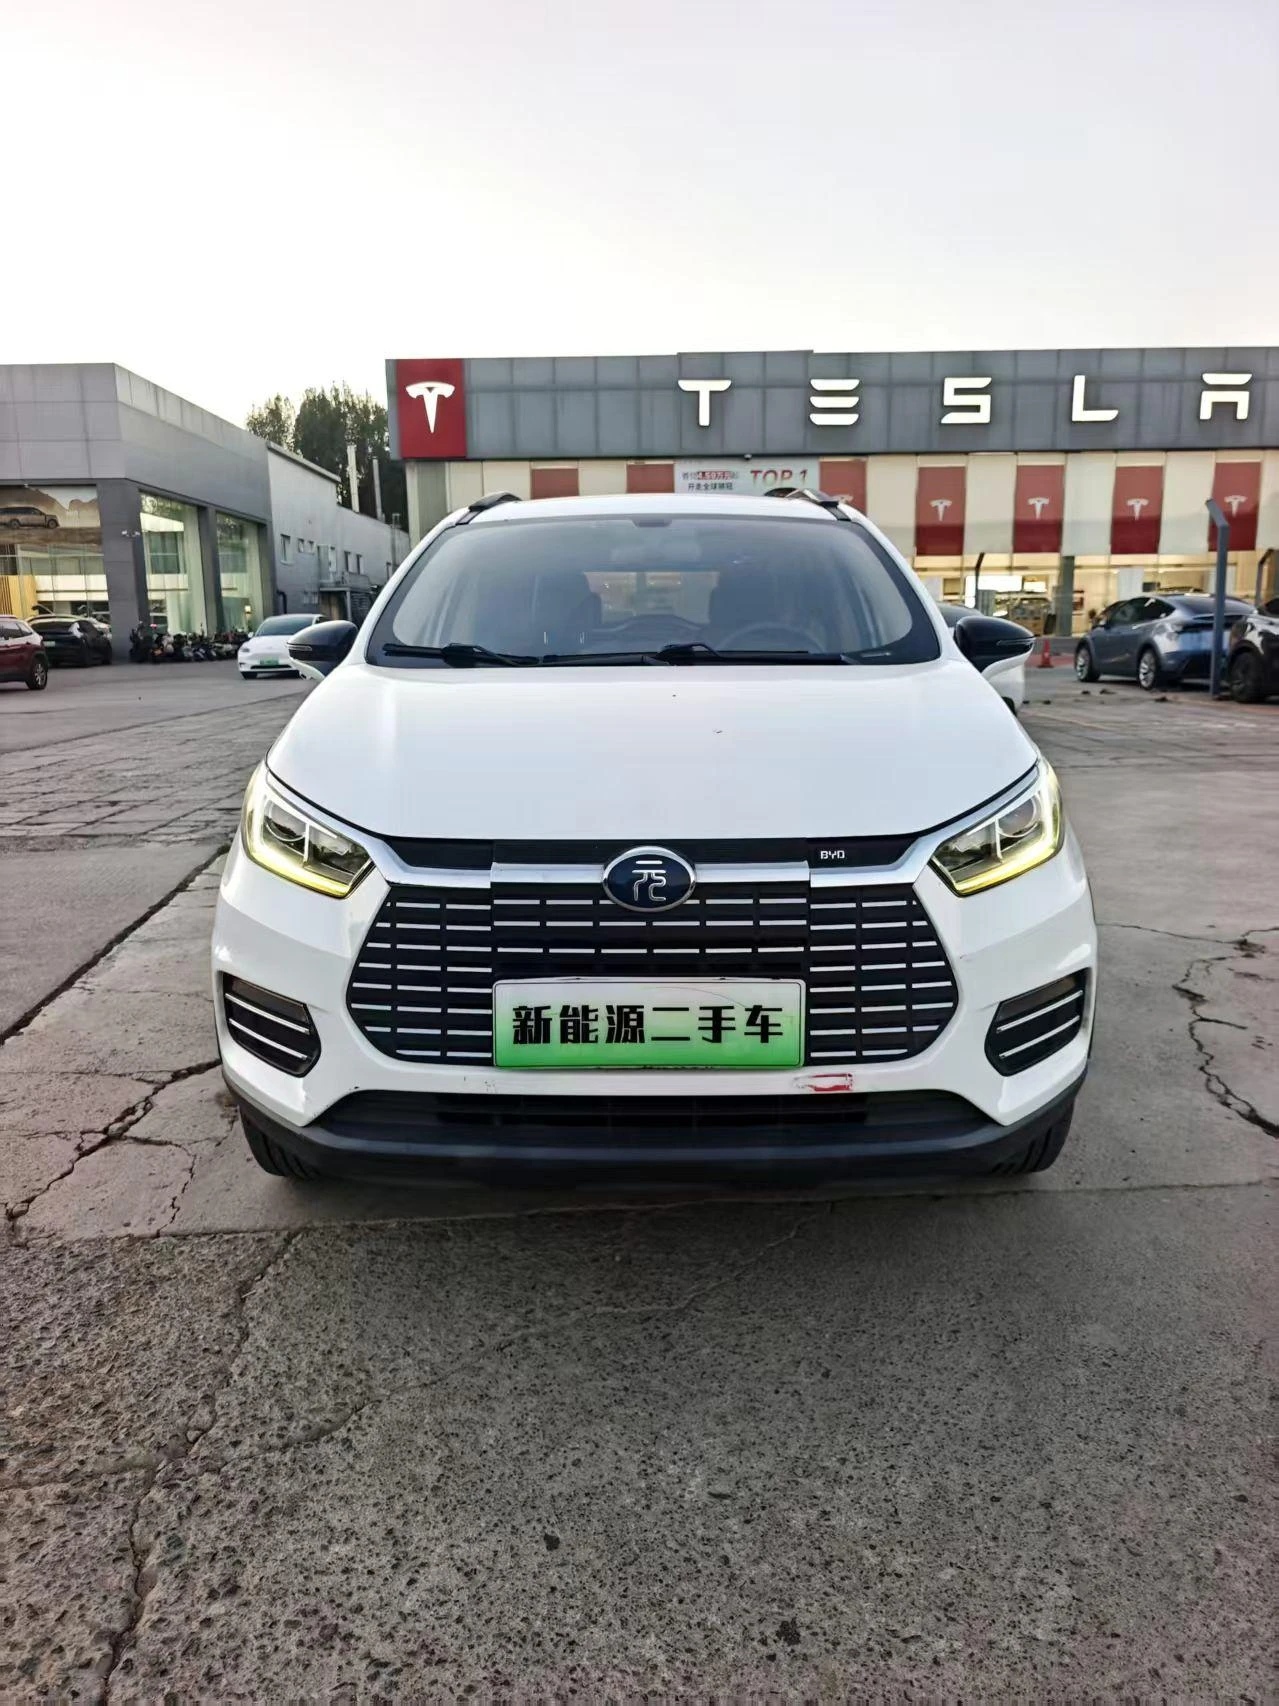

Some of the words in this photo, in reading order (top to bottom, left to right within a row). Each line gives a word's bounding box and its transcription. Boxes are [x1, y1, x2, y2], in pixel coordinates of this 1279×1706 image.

[677, 372, 1252, 426] TESLA
[750, 469, 794, 486] TOP
[800, 469, 809, 486] 1
[820, 849, 846, 860] BYD
[513, 1004, 784, 1045] 新能源二手车
